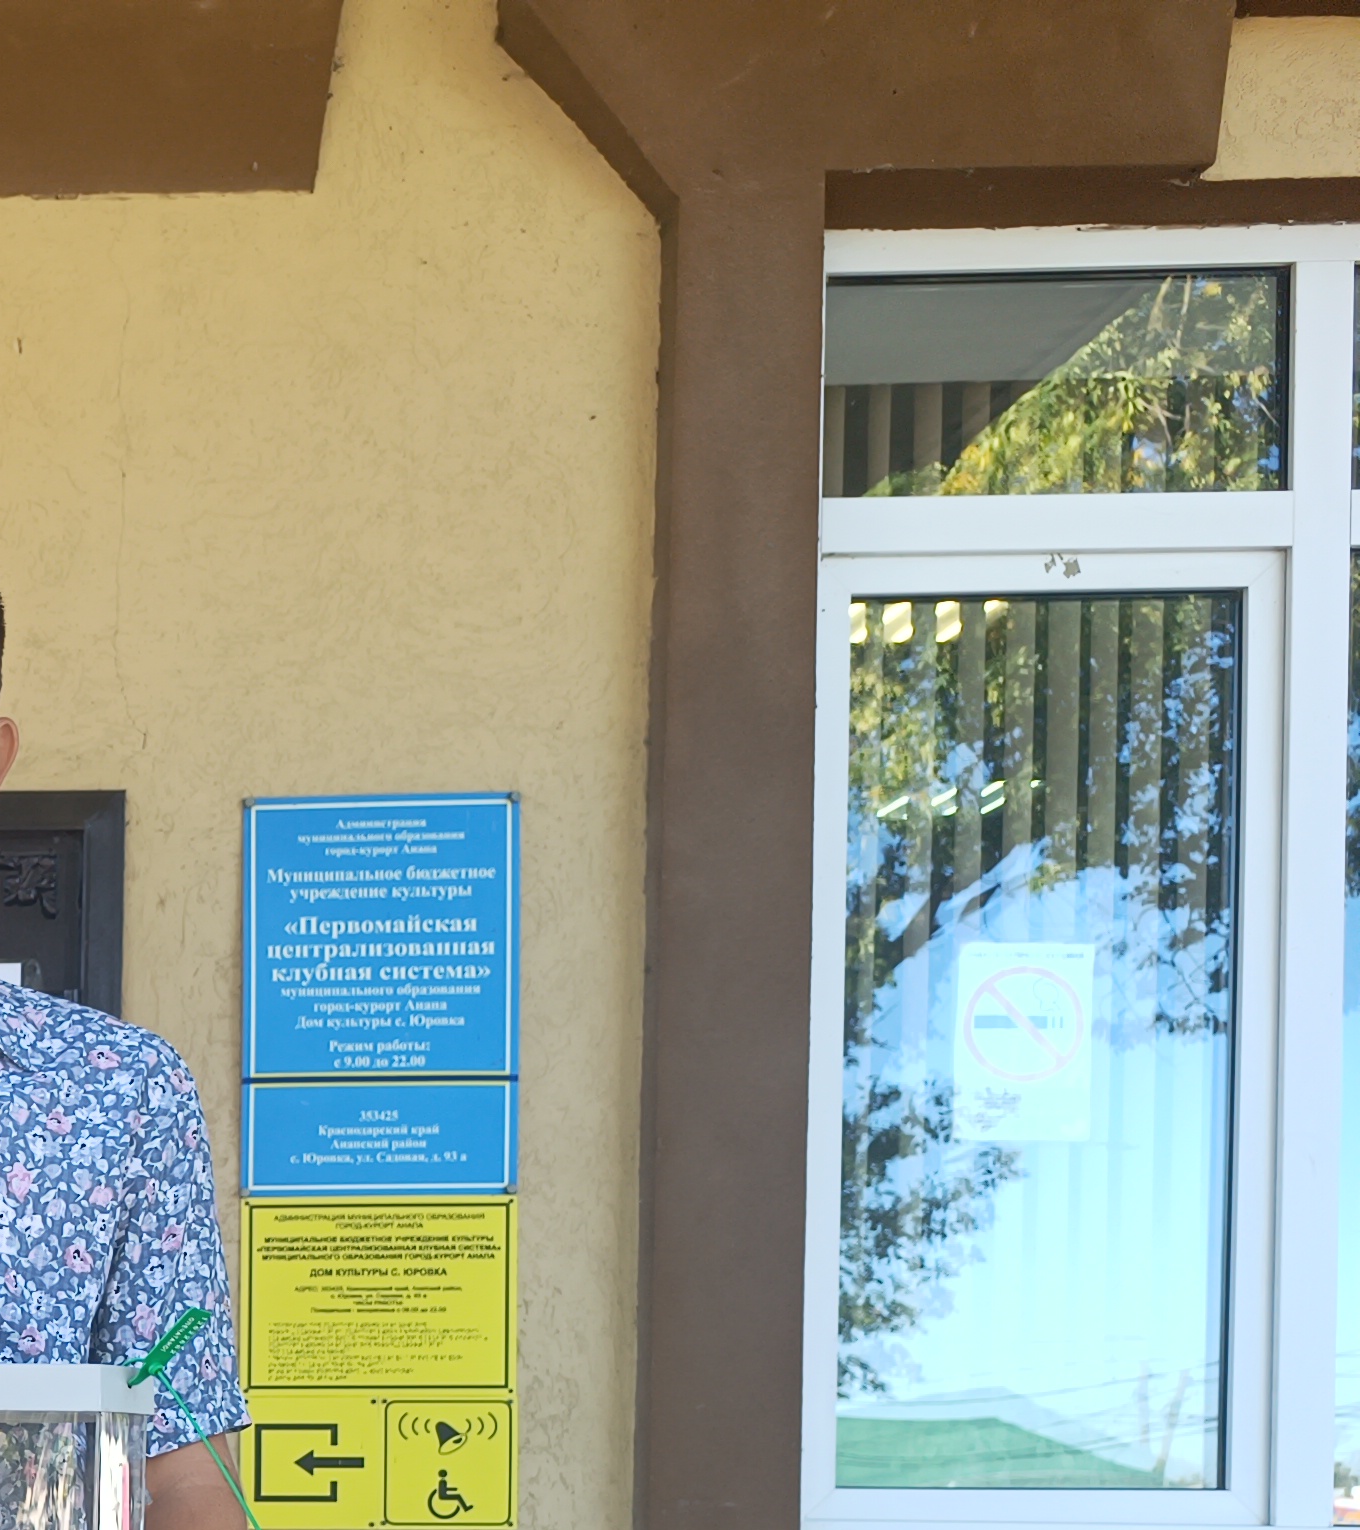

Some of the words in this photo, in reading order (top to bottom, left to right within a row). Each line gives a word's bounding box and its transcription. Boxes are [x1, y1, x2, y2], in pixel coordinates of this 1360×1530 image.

[336, 818, 426, 829] Администрация
[298, 831, 391, 844] муниципального
[395, 830, 465, 841] образования
[325, 845, 398, 857] город-курорт
[401, 844, 437, 854] Анапа
[267, 868, 401, 886] Муниципальное
[407, 865, 496, 881] бюджетное
[290, 886, 387, 903] учреждение
[392, 885, 472, 900] культуры
[284, 915, 477, 938] «Первомайская
[267, 940, 495, 961] централизованная
[272, 965, 371, 985] клубная
[379, 964, 490, 980] система»
[281, 986, 393, 999] муниципального
[397, 984, 480, 996] образования
[314, 1001, 400, 1013] город-курорт
[405, 1000, 447, 1011] Анапа
[295, 1016, 324, 1030] Дом
[327, 1016, 391, 1030] культуры
[395, 1017, 406, 1027] с.
[409, 1015, 464, 1028] Юровка
[329, 1040, 373, 1052] Режим
[377, 1039, 430, 1053] работы:
[334, 1058, 341, 1068] с
[344, 1056, 370, 1068] 9.00
[373, 1057, 388, 1069] до
[392, 1055, 425, 1067] 22.00
[318, 1125, 408, 1137] Краснодарский
[411, 1123, 439, 1136] край
[331, 1139, 388, 1149] Анапский
[392, 1138, 426, 1151] район
[310, 1268, 332, 1277] ДОМ
[336, 1268, 388, 1276] КУЛЬТУРЫ
[391, 1268, 400, 1276] С.
[403, 1267, 447, 1276] ЮРОВКА
